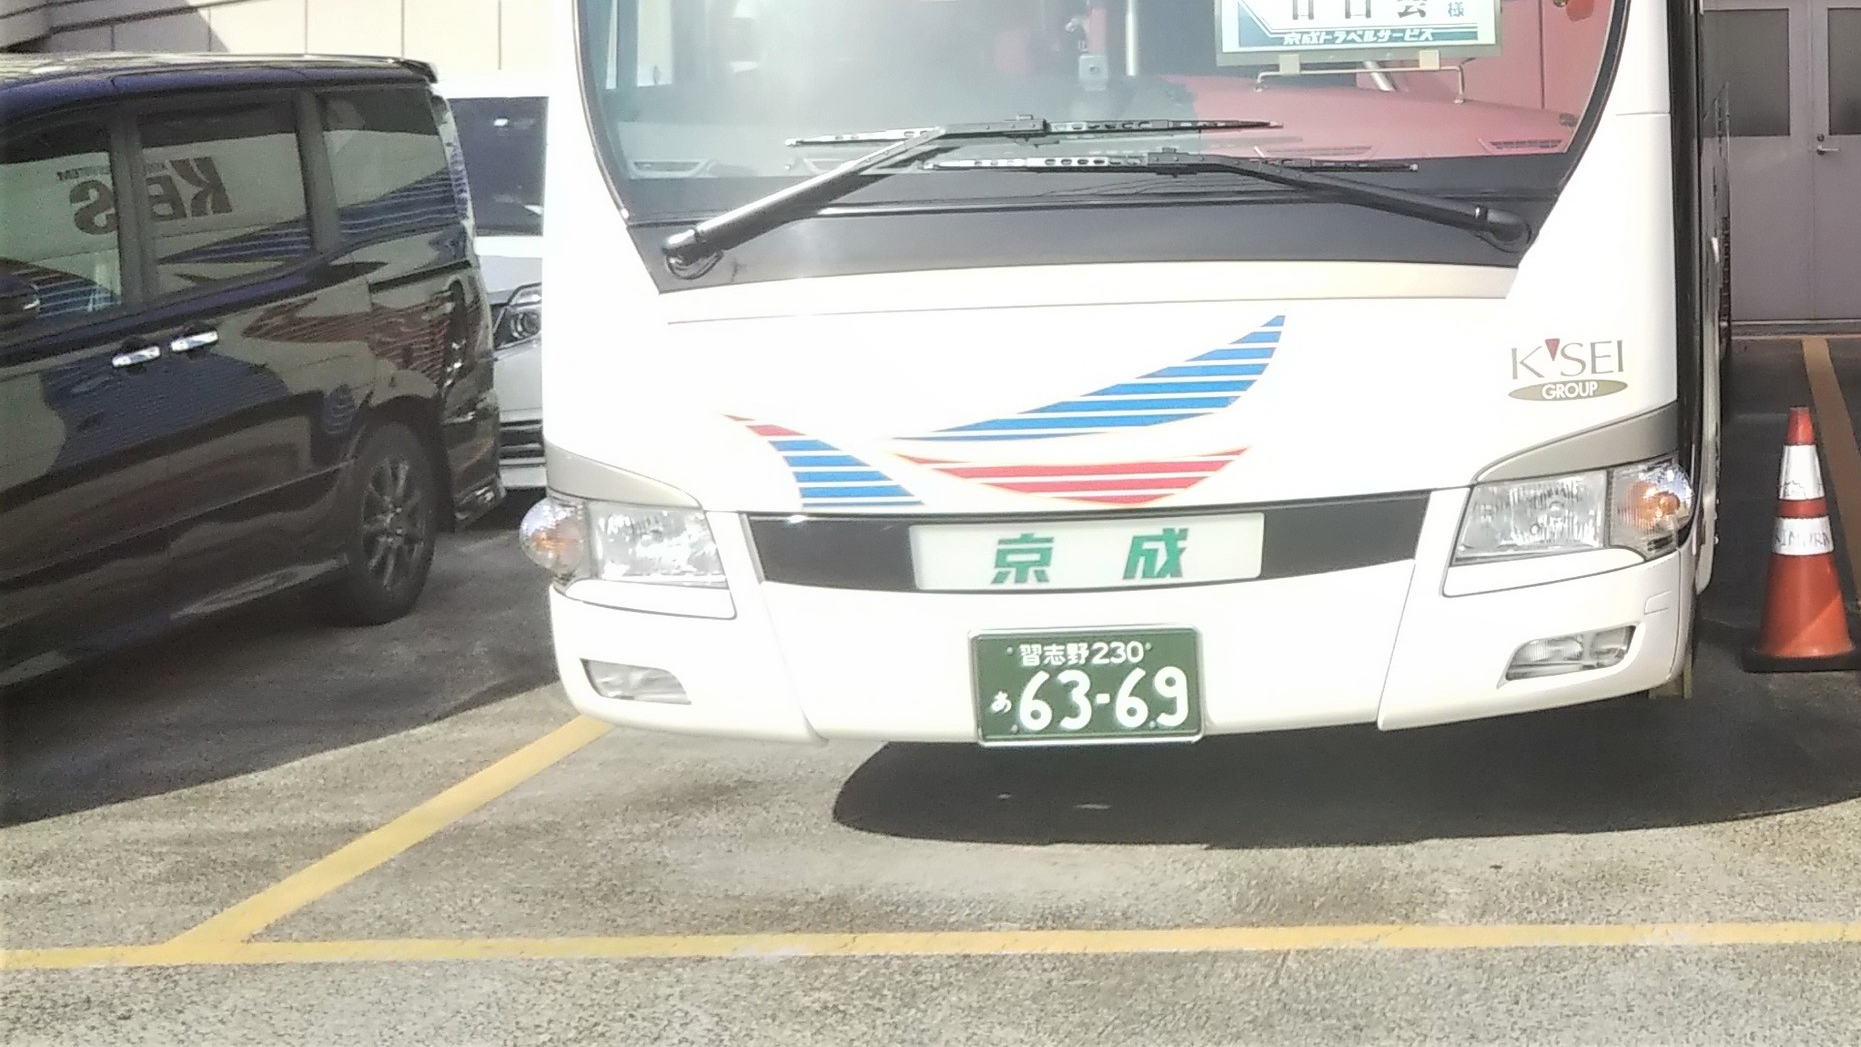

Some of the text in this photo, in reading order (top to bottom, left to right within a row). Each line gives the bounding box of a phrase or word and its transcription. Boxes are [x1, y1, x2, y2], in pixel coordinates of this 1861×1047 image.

[1282, 28, 1434, 46] 京成トラベルサービス
[1541, 380, 1599, 400] GROUP
[990, 527, 1190, 586] 京成
[990, 666, 1190, 732] あ 63-69
